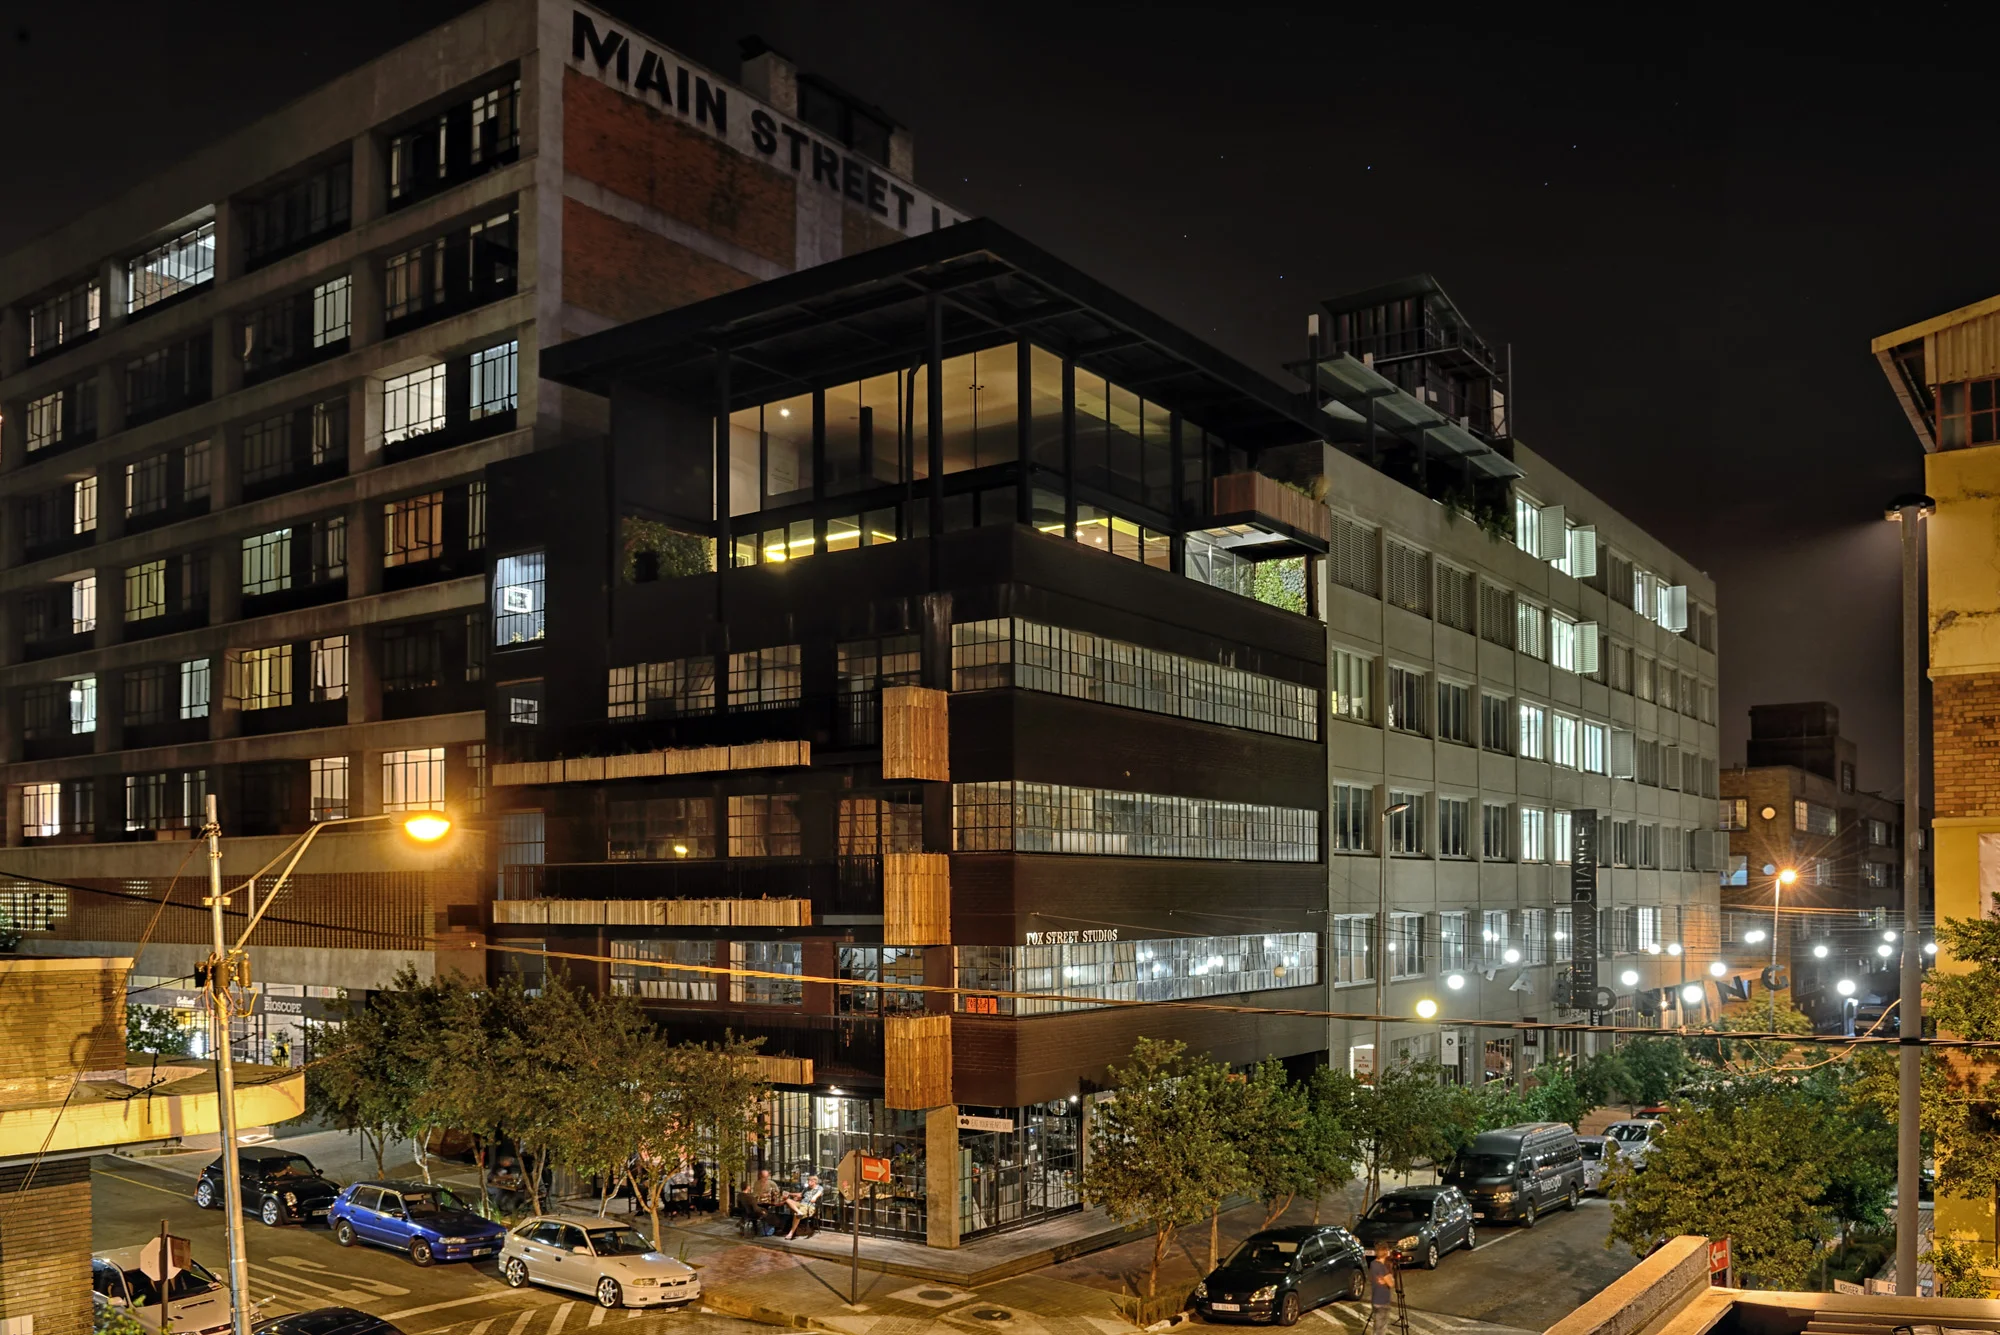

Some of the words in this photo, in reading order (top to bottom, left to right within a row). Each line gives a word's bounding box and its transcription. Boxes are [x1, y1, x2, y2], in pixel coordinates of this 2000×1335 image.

[572, 9, 728, 135] MAIN
[751, 109, 915, 230] STREET
[12, 892, 56, 931] LIFE
[1026, 932, 1044, 946] FOX
[1046, 930, 1079, 945] STREET
[1082, 928, 1118, 943] STUDIOS
[1576, 913, 1592, 960] MAIN
[264, 1000, 302, 1013] BIOSCOPE
[1840, 1283, 1859, 1294] KRUGER
